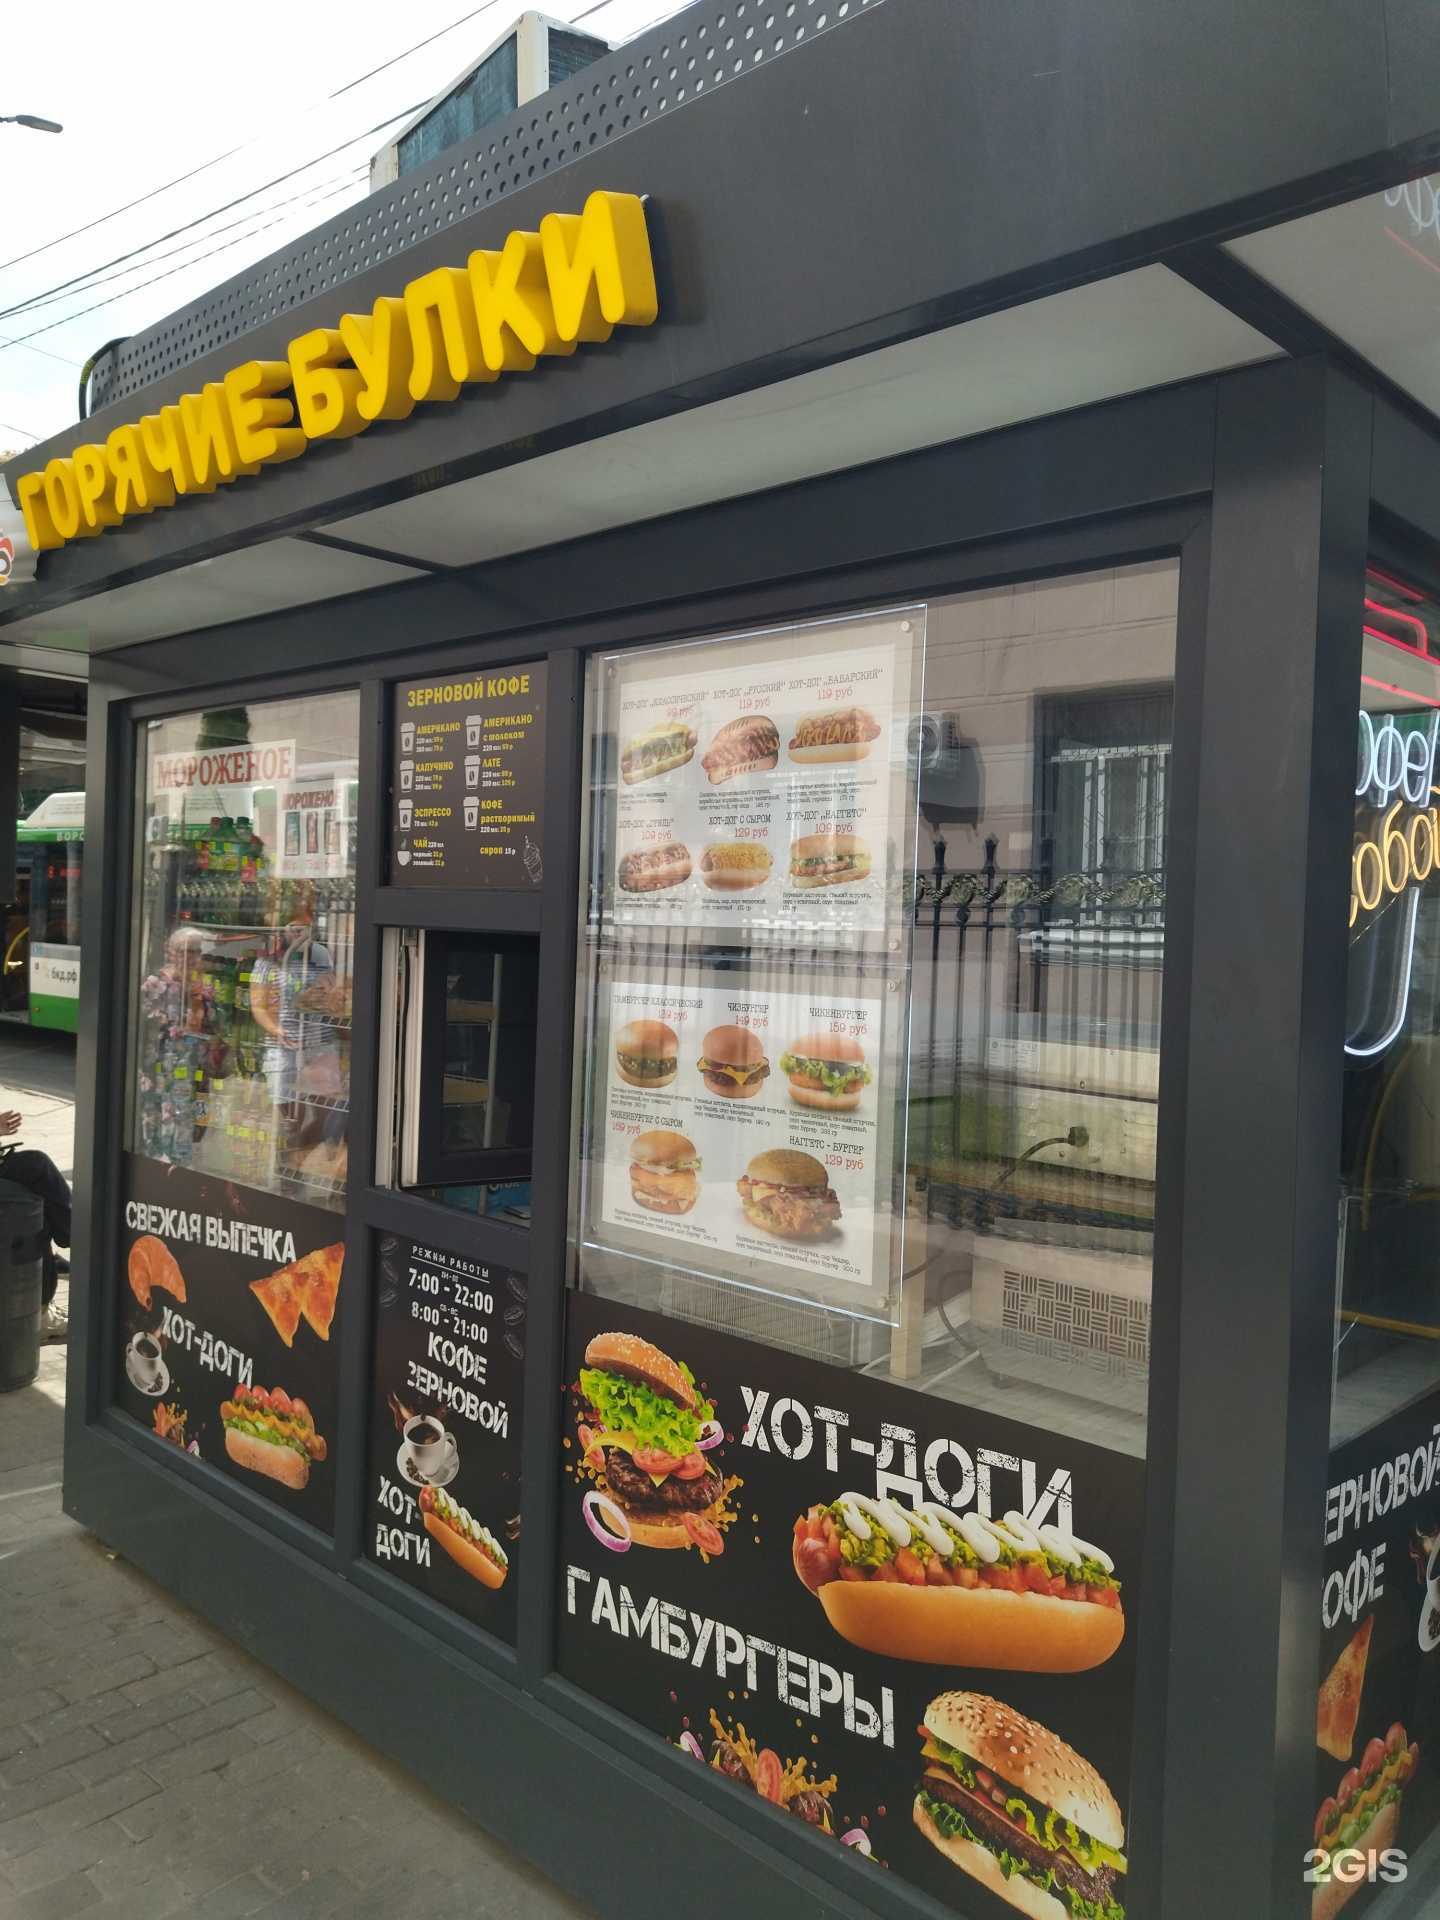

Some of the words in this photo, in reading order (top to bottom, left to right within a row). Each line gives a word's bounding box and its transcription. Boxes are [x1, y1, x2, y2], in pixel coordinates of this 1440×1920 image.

[18, 360, 308, 551] ГОРЯЧИЕ
[288, 190, 658, 439] БУЛКИ
[408, 676, 483, 707] ЗЕРНОВОЙ
[488, 675, 530, 697] КОФЕ
[817, 688, 833, 700] 119
[835, 686, 853, 700] руб
[738, 697, 752, 710] 119
[753, 696, 770, 711] руб
[416, 721, 461, 735] АМЕРИКАНО
[483, 714, 532, 728] АМЕРИКАНО
[157, 747, 292, 788] МОРОЖЕНОЕ
[416, 761, 454, 773] КАПУЧИНО
[414, 807, 452, 817] ЭСПРЕССО
[481, 799, 503, 809] КОФЕ
[480, 811, 535, 825] растворимый
[708, 815, 738, 825] ХОТ-ДОГ
[746, 813, 771, 824] СЫРОМ
[735, 827, 750, 838] 129
[752, 826, 768, 839] руб
[835, 822, 853, 834] руб
[414, 836, 428, 848] ЧАЙ
[480, 846, 503, 856] сироп
[752, 1015, 769, 1028] руб
[809, 1007, 868, 1020] ЧИКЕНБУРГЕР
[829, 1022, 846, 1033] 159
[849, 1023, 867, 1036] руб
[789, 1135, 825, 1149] НАГГЕТС
[833, 1142, 865, 1155] БУРГЕР
[825, 1154, 842, 1166] 129
[846, 1158, 864, 1170] руб
[125, 1200, 202, 1244] СВЕЖАЯ
[204, 1215, 297, 1264] ВЫПЕЧКА
[412, 1245, 446, 1264] РЕЖИМ
[450, 1257, 489, 1278] РАБОТЫ
[409, 1267, 439, 1295] 7:00
[454, 1283, 493, 1314] 22:00
[411, 1301, 440, 1326] 8:00
[453, 1316, 488, 1344] 21:00
[161, 1305, 253, 1390] ХОТ-ДОГИ
[428, 1332, 488, 1386] КОФЕ
[406, 1360, 509, 1439] ЗЕРНОВОЙ
[740, 1385, 1075, 1537] ХОТ-ДОГИ
[1324, 1423, 1440, 1546] ЕРНОВОЙ
[378, 1474, 422, 1525] ХОТ-
[375, 1523, 431, 1568] ДОГИ
[1321, 1541, 1387, 1630] ОФЕ
[566, 1564, 895, 1748] ГАМБУРГЕРЫ
